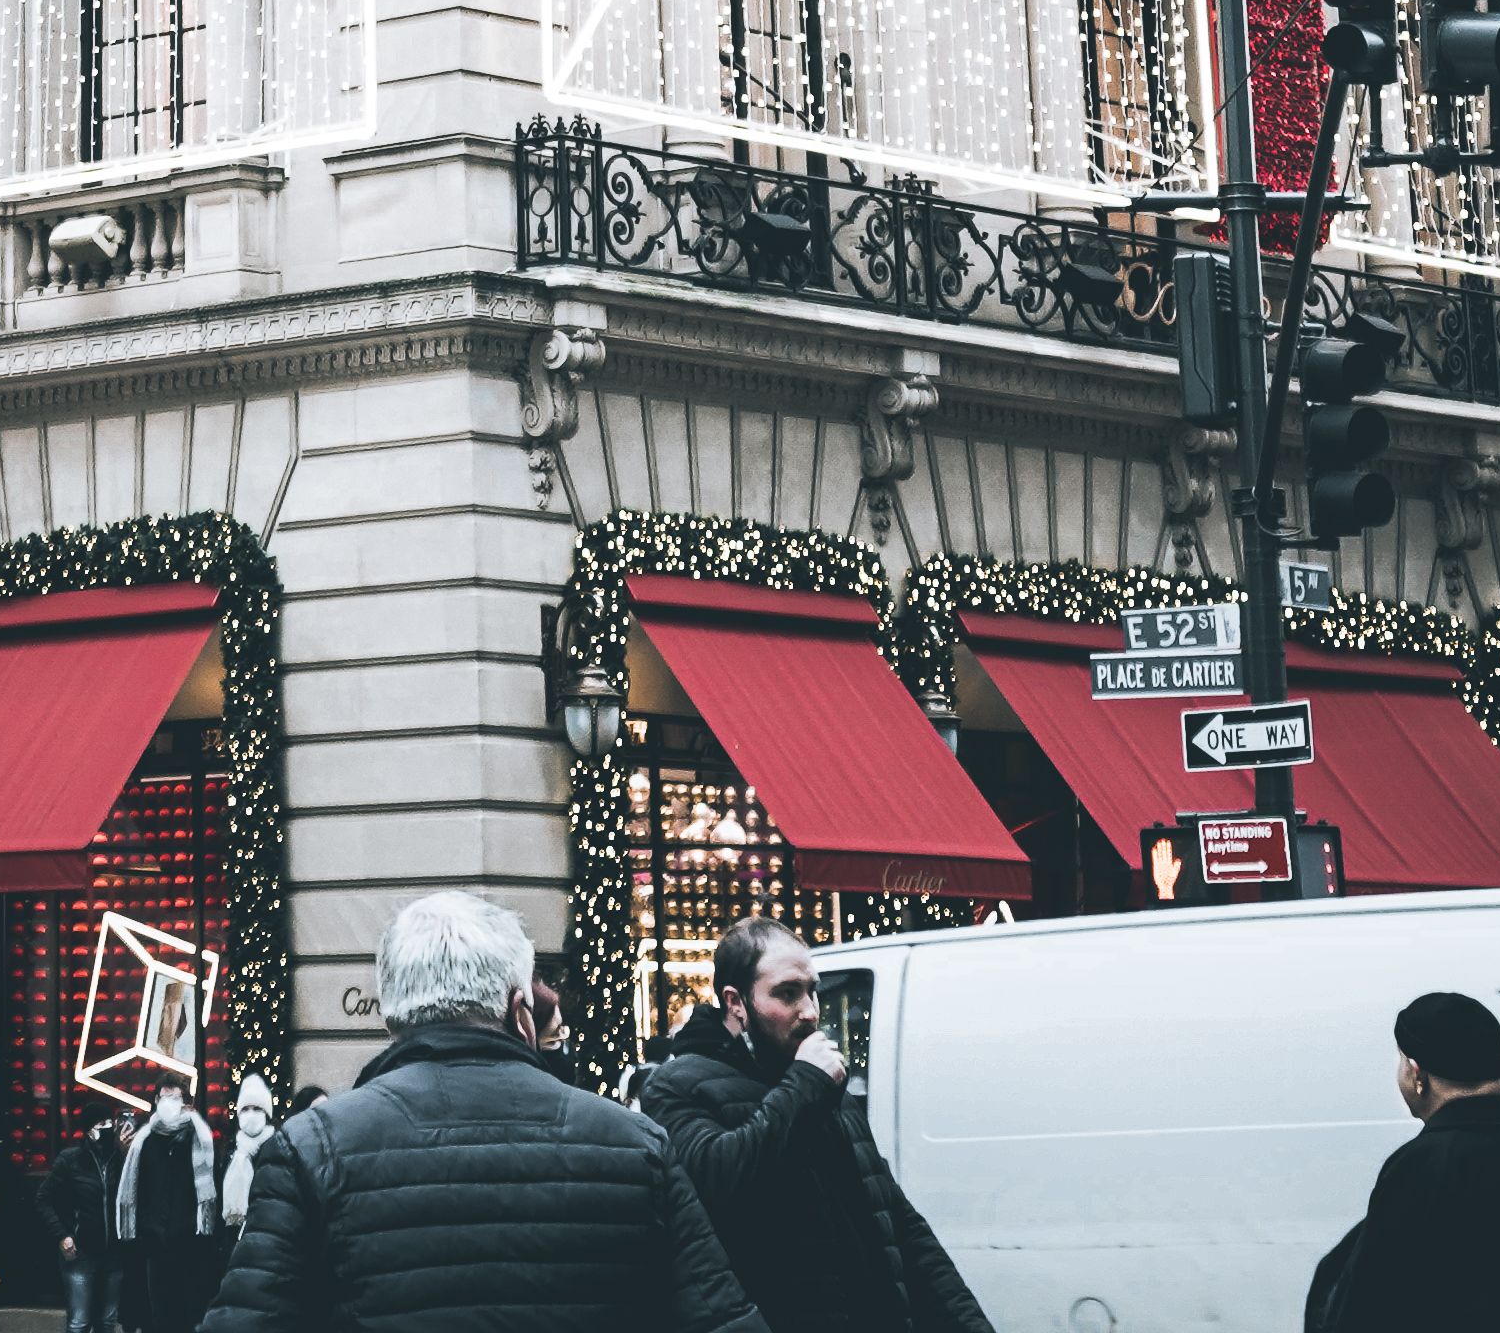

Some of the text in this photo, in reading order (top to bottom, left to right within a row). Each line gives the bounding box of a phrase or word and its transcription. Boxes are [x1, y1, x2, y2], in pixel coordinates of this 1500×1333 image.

[1293, 570, 1306, 603] 5
[1126, 609, 1216, 649] E 52 ST
[1096, 661, 1146, 690] PLACE
[1171, 660, 1236, 687] CARTIER
[1207, 723, 1298, 751] ONE WAY
[1205, 826, 1273, 840] NO STANDING
[1207, 841, 1250, 856] Anytime
[882, 859, 948, 893] Cartier
